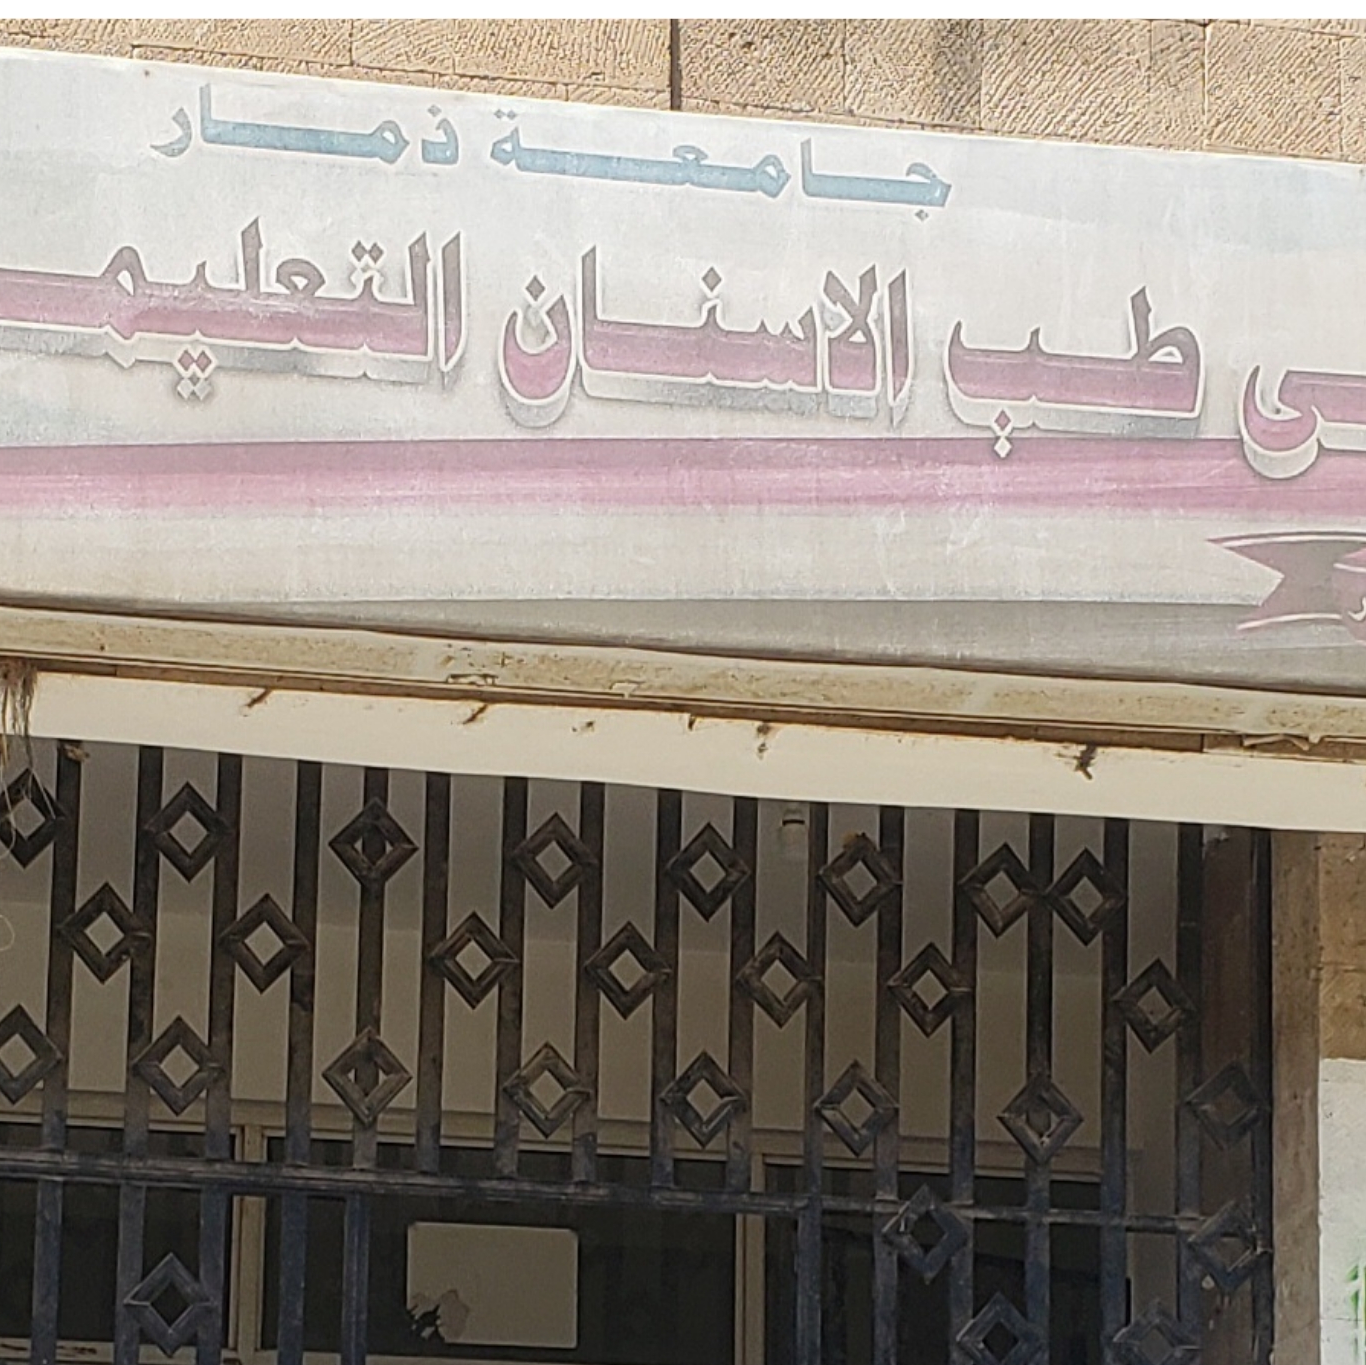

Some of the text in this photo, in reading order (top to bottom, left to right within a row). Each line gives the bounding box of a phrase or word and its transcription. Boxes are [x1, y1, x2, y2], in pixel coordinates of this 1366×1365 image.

[149, 82, 953, 222] جامعة ذمار
[499, 243, 915, 427] الاسنان
[943, 283, 1205, 458] طب
